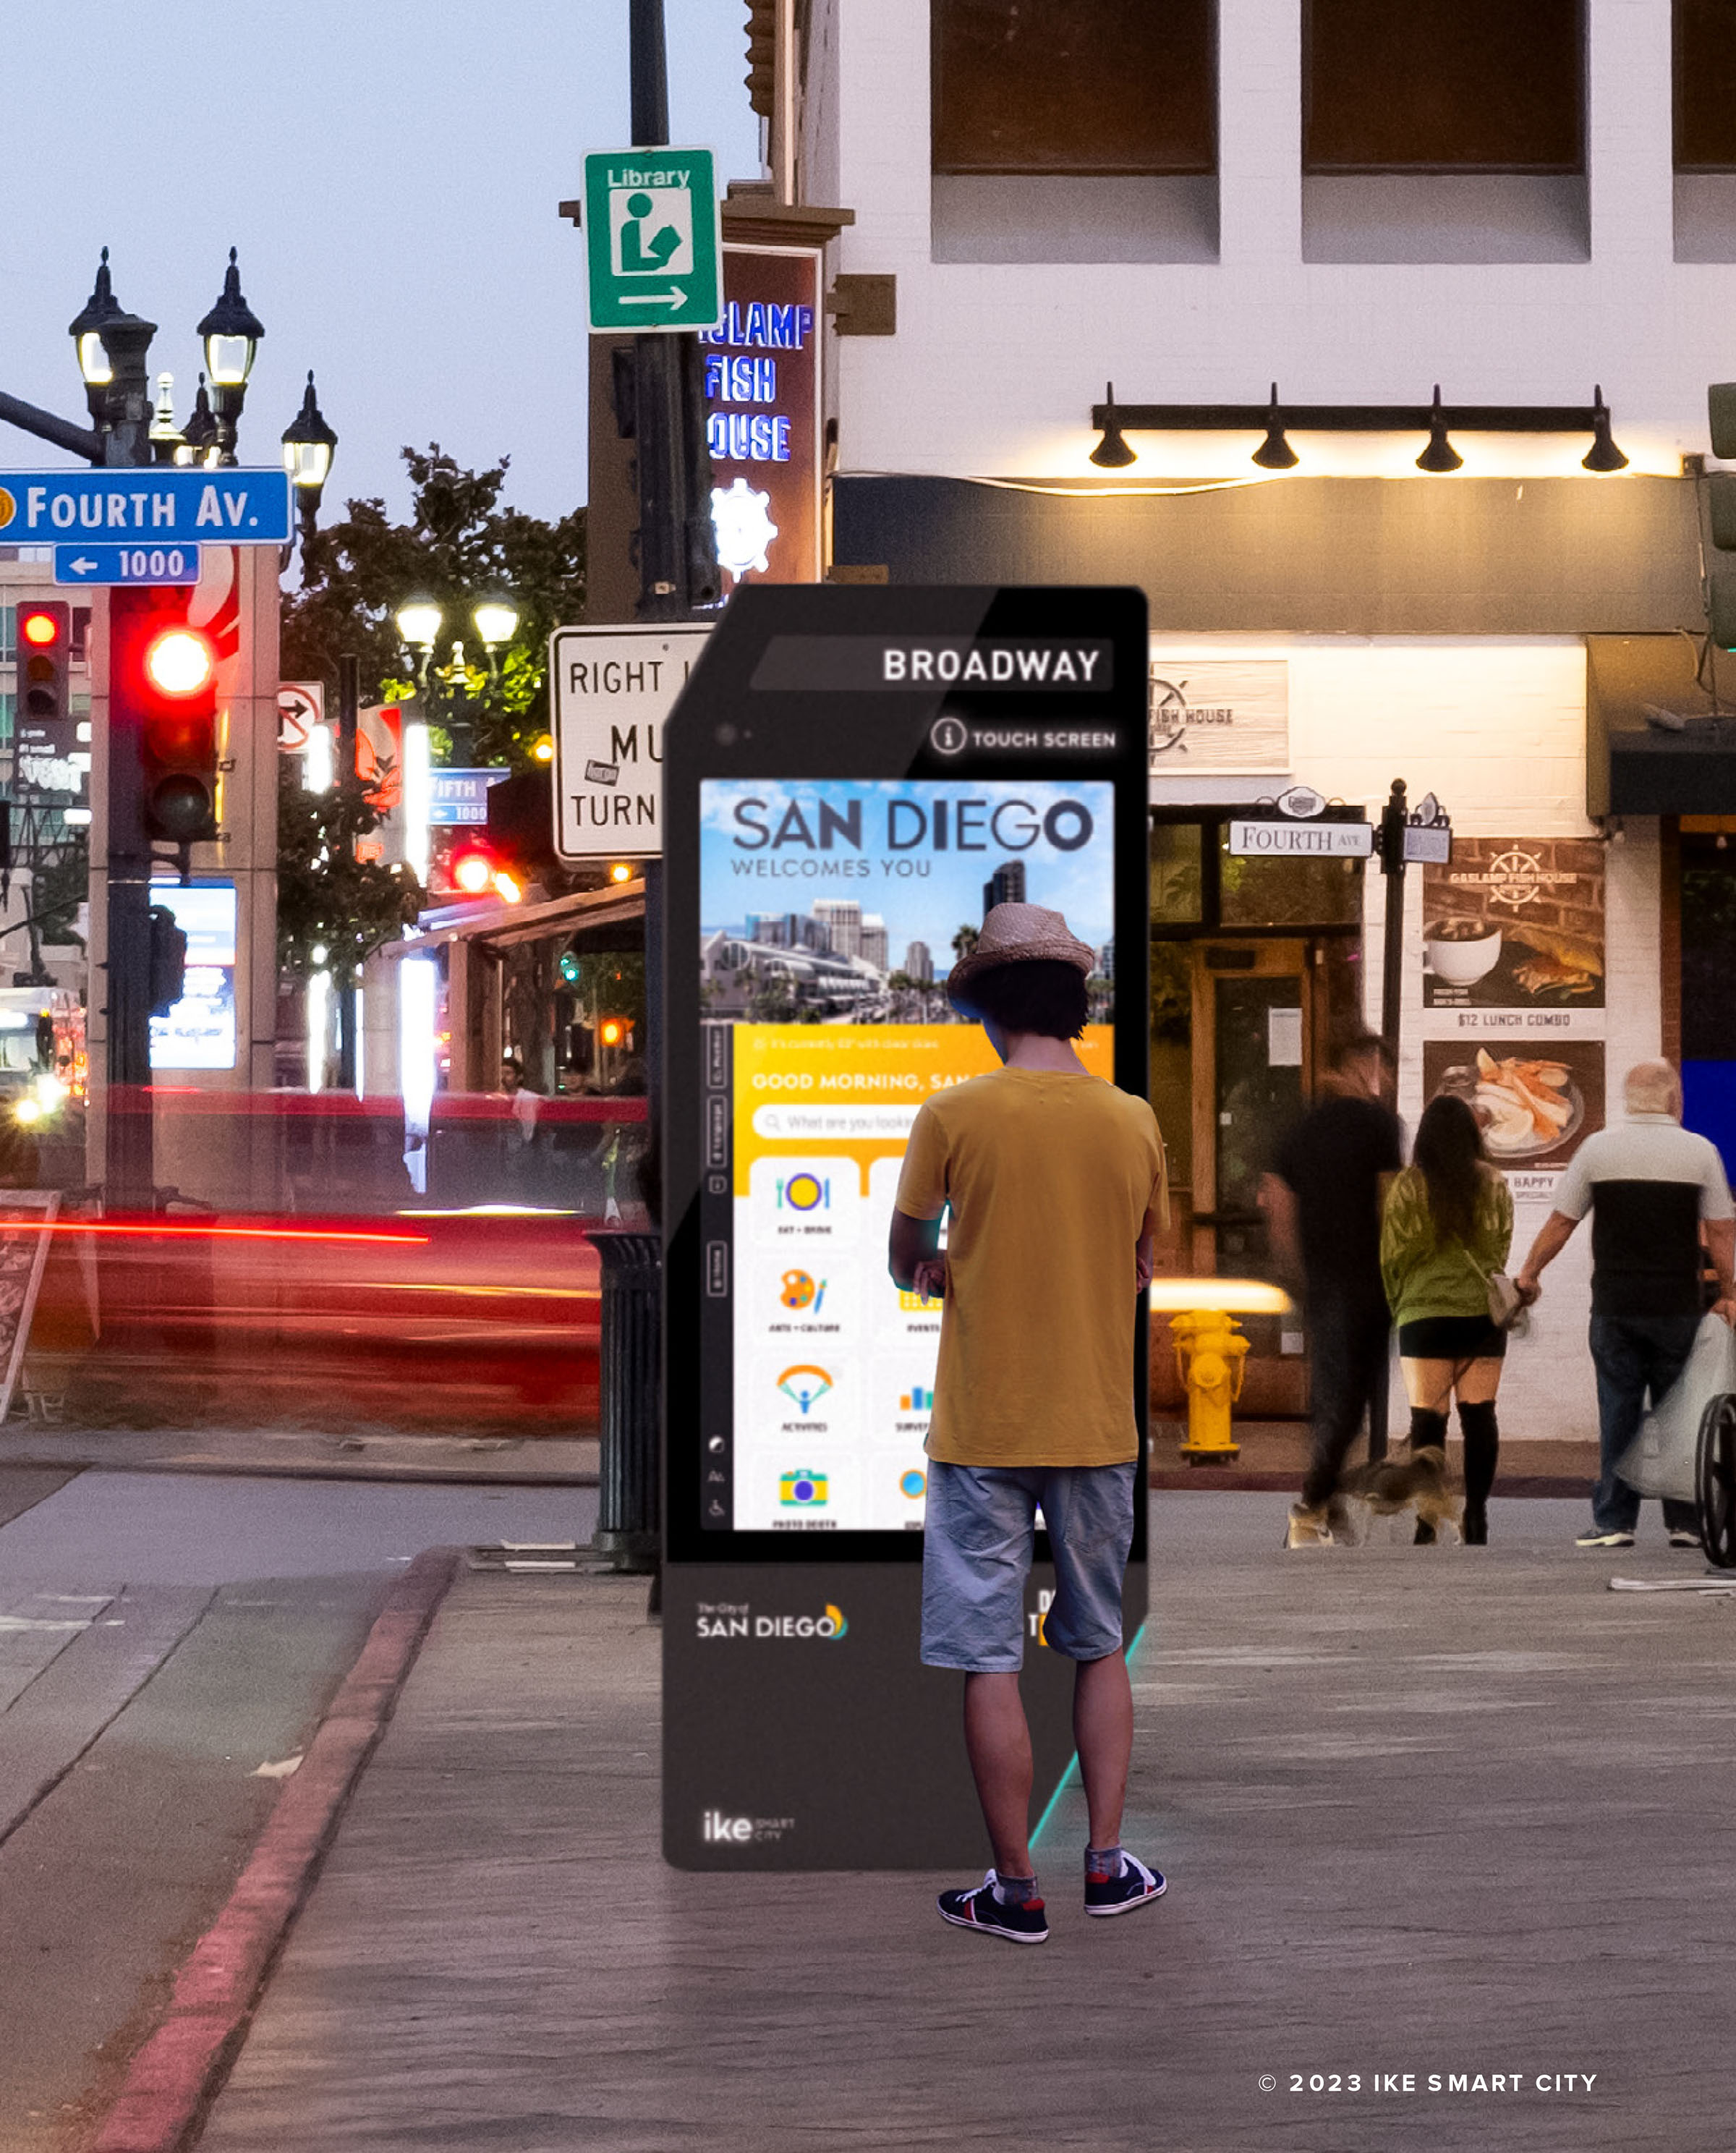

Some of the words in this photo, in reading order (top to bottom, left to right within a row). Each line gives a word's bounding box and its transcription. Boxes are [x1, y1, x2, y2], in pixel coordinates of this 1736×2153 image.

[608, 169, 691, 190] Library
[705, 354, 776, 403] FISH
[707, 412, 791, 461] OUSE
[27, 487, 175, 528] FOURTH
[196, 485, 258, 527] AV.
[119, 550, 184, 577] 1000
[570, 661, 663, 694] RIGHT
[884, 650, 1099, 681] BROADWAY
[1186, 709, 1233, 723] HOUSE
[611, 724, 663, 763] MU
[972, 732, 1037, 747] TOUCH
[1044, 732, 1115, 747] SCREEN
[571, 794, 655, 825] TURN
[733, 798, 861, 852] SAN
[888, 799, 1093, 852] DIEGO
[1243, 826, 1331, 851] FOURTH
[731, 859, 869, 878] WELCOMES
[881, 859, 930, 878] YOU
[1537, 873, 1577, 883] HOUSE
[1484, 1014, 1522, 1026] LUNCH
[1527, 1014, 1570, 1026] COMBO
[752, 1073, 813, 1090] GOOD
[820, 1073, 924, 1092] MORNING,
[787, 1115, 822, 1129] What
[827, 1118, 846, 1129] are
[851, 1118, 872, 1133] you
[697, 1616, 748, 1636] SAN
[756, 1616, 835, 1636] DIEGO
[704, 1811, 752, 1841] ike
